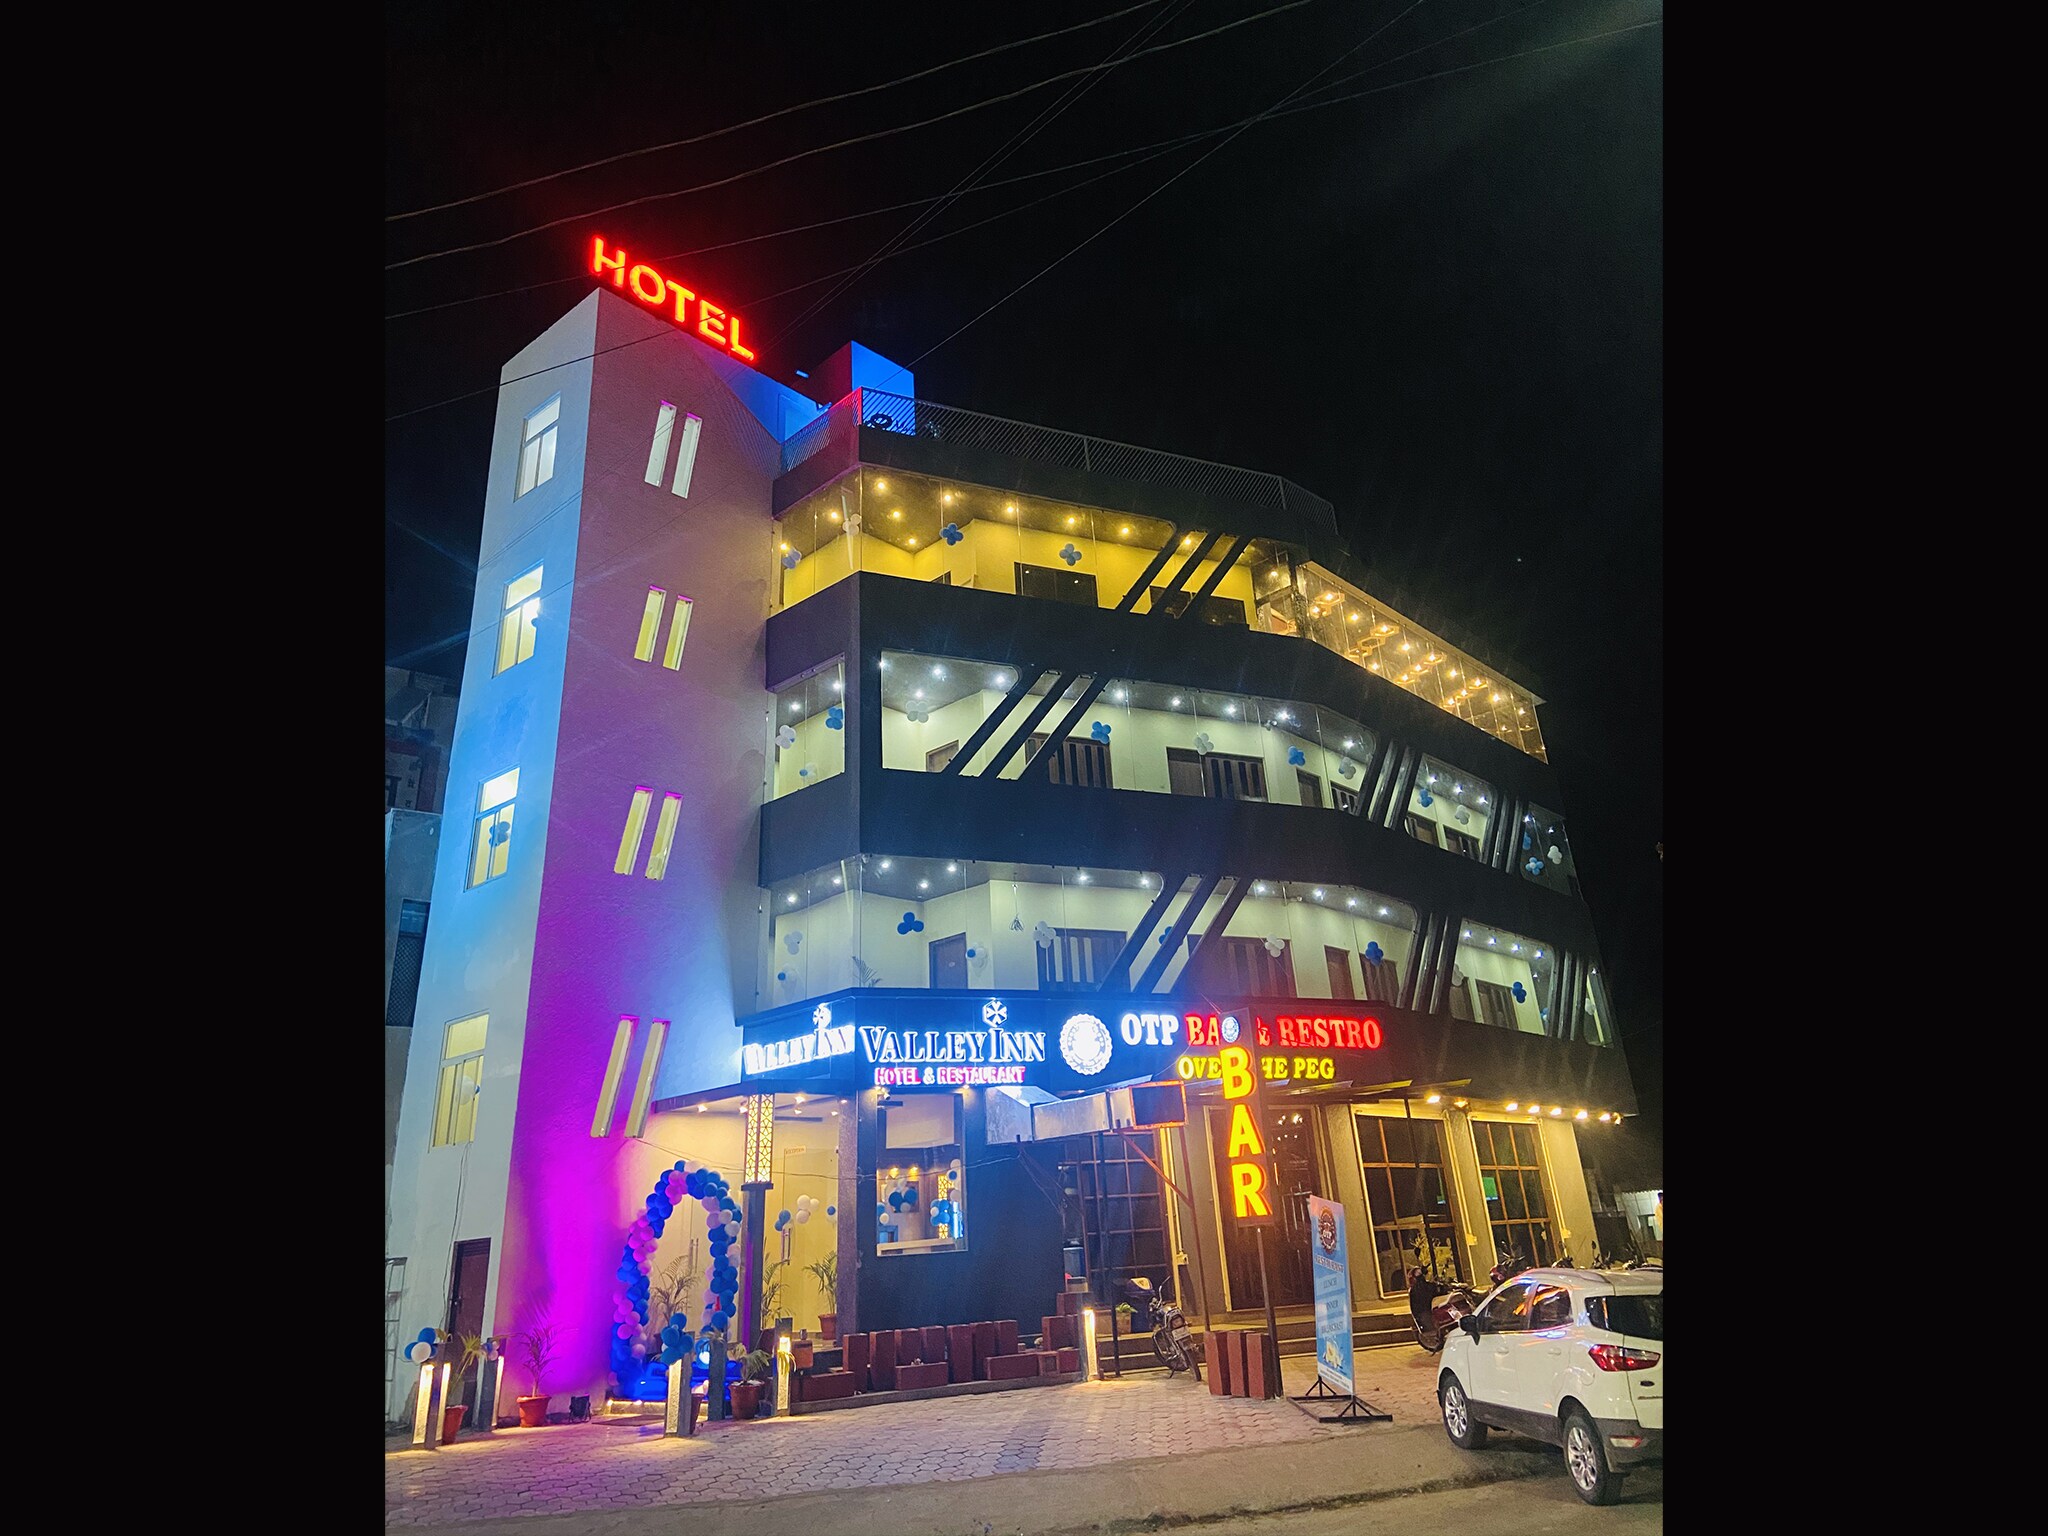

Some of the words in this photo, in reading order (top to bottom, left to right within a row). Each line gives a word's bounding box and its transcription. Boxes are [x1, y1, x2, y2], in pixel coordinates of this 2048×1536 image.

[592, 236, 756, 361] HOTEL
[1121, 1014, 1179, 1046] OTP
[1185, 1016, 1219, 1046] BA
[1277, 1018, 1381, 1049] RESTRO
[874, 1067, 922, 1085] HOTEL
[923, 1068, 935, 1084] &
[938, 1066, 1026, 1085] RESTAURANT
[1178, 1056, 1222, 1080] OVE
[1261, 1057, 1288, 1079] HE
[1293, 1057, 1335, 1080] PEG
[1219, 1046, 1271, 1219] BAR
